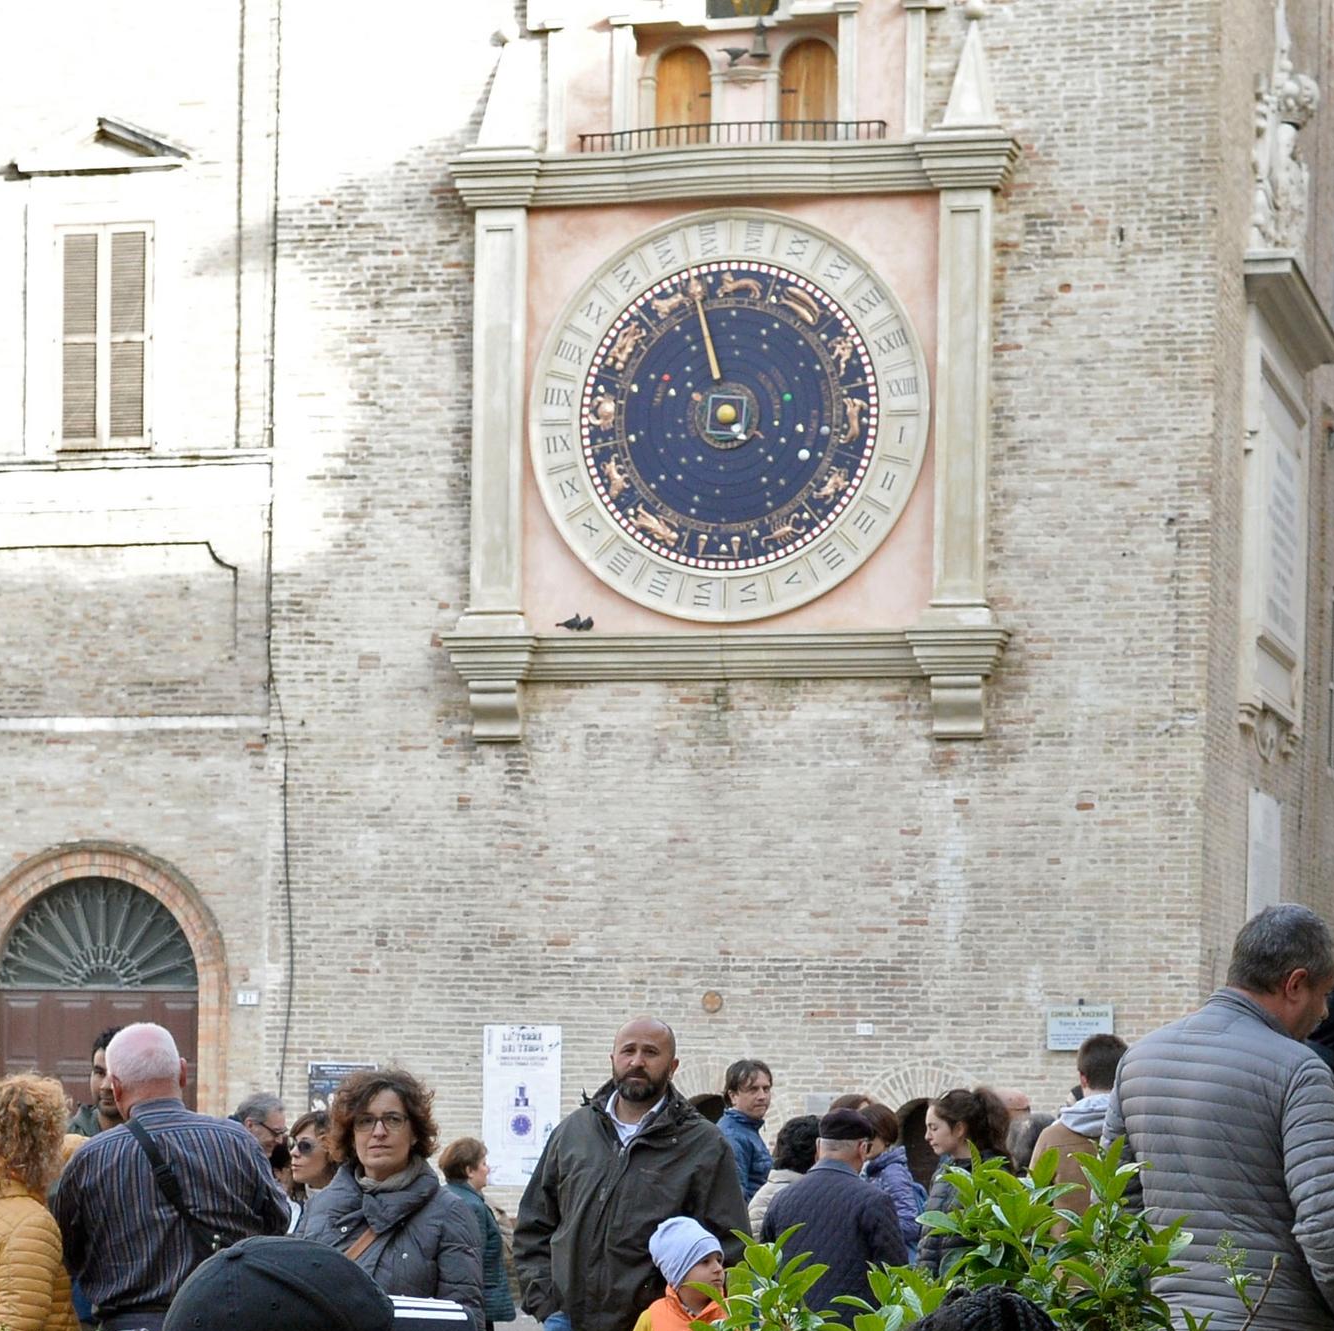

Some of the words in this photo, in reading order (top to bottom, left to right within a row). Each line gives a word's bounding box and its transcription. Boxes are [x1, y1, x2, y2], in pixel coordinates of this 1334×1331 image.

[653, 236, 679, 269] XVII
[786, 234, 810, 262] XX
[613, 262, 641, 293] XVI
[823, 254, 851, 286] XXI
[580, 301, 608, 326] XV
[853, 285, 885, 318] XXII
[555, 339, 588, 366] XIIII
[873, 328, 909, 357] XXIII
[543, 387, 574, 407] XIII
[545, 434, 571, 455] XII
[897, 425, 905, 444] I
[559, 477, 580, 499] XI
[879, 471, 897, 491] II
[581, 518, 599, 538] X
[853, 511, 876, 535] III
[818, 542, 846, 571] IIII
[647, 569, 673, 598] VIII
[785, 571, 802, 586] V
[693, 581, 713, 607] VII
[740, 582, 758, 603] VI
